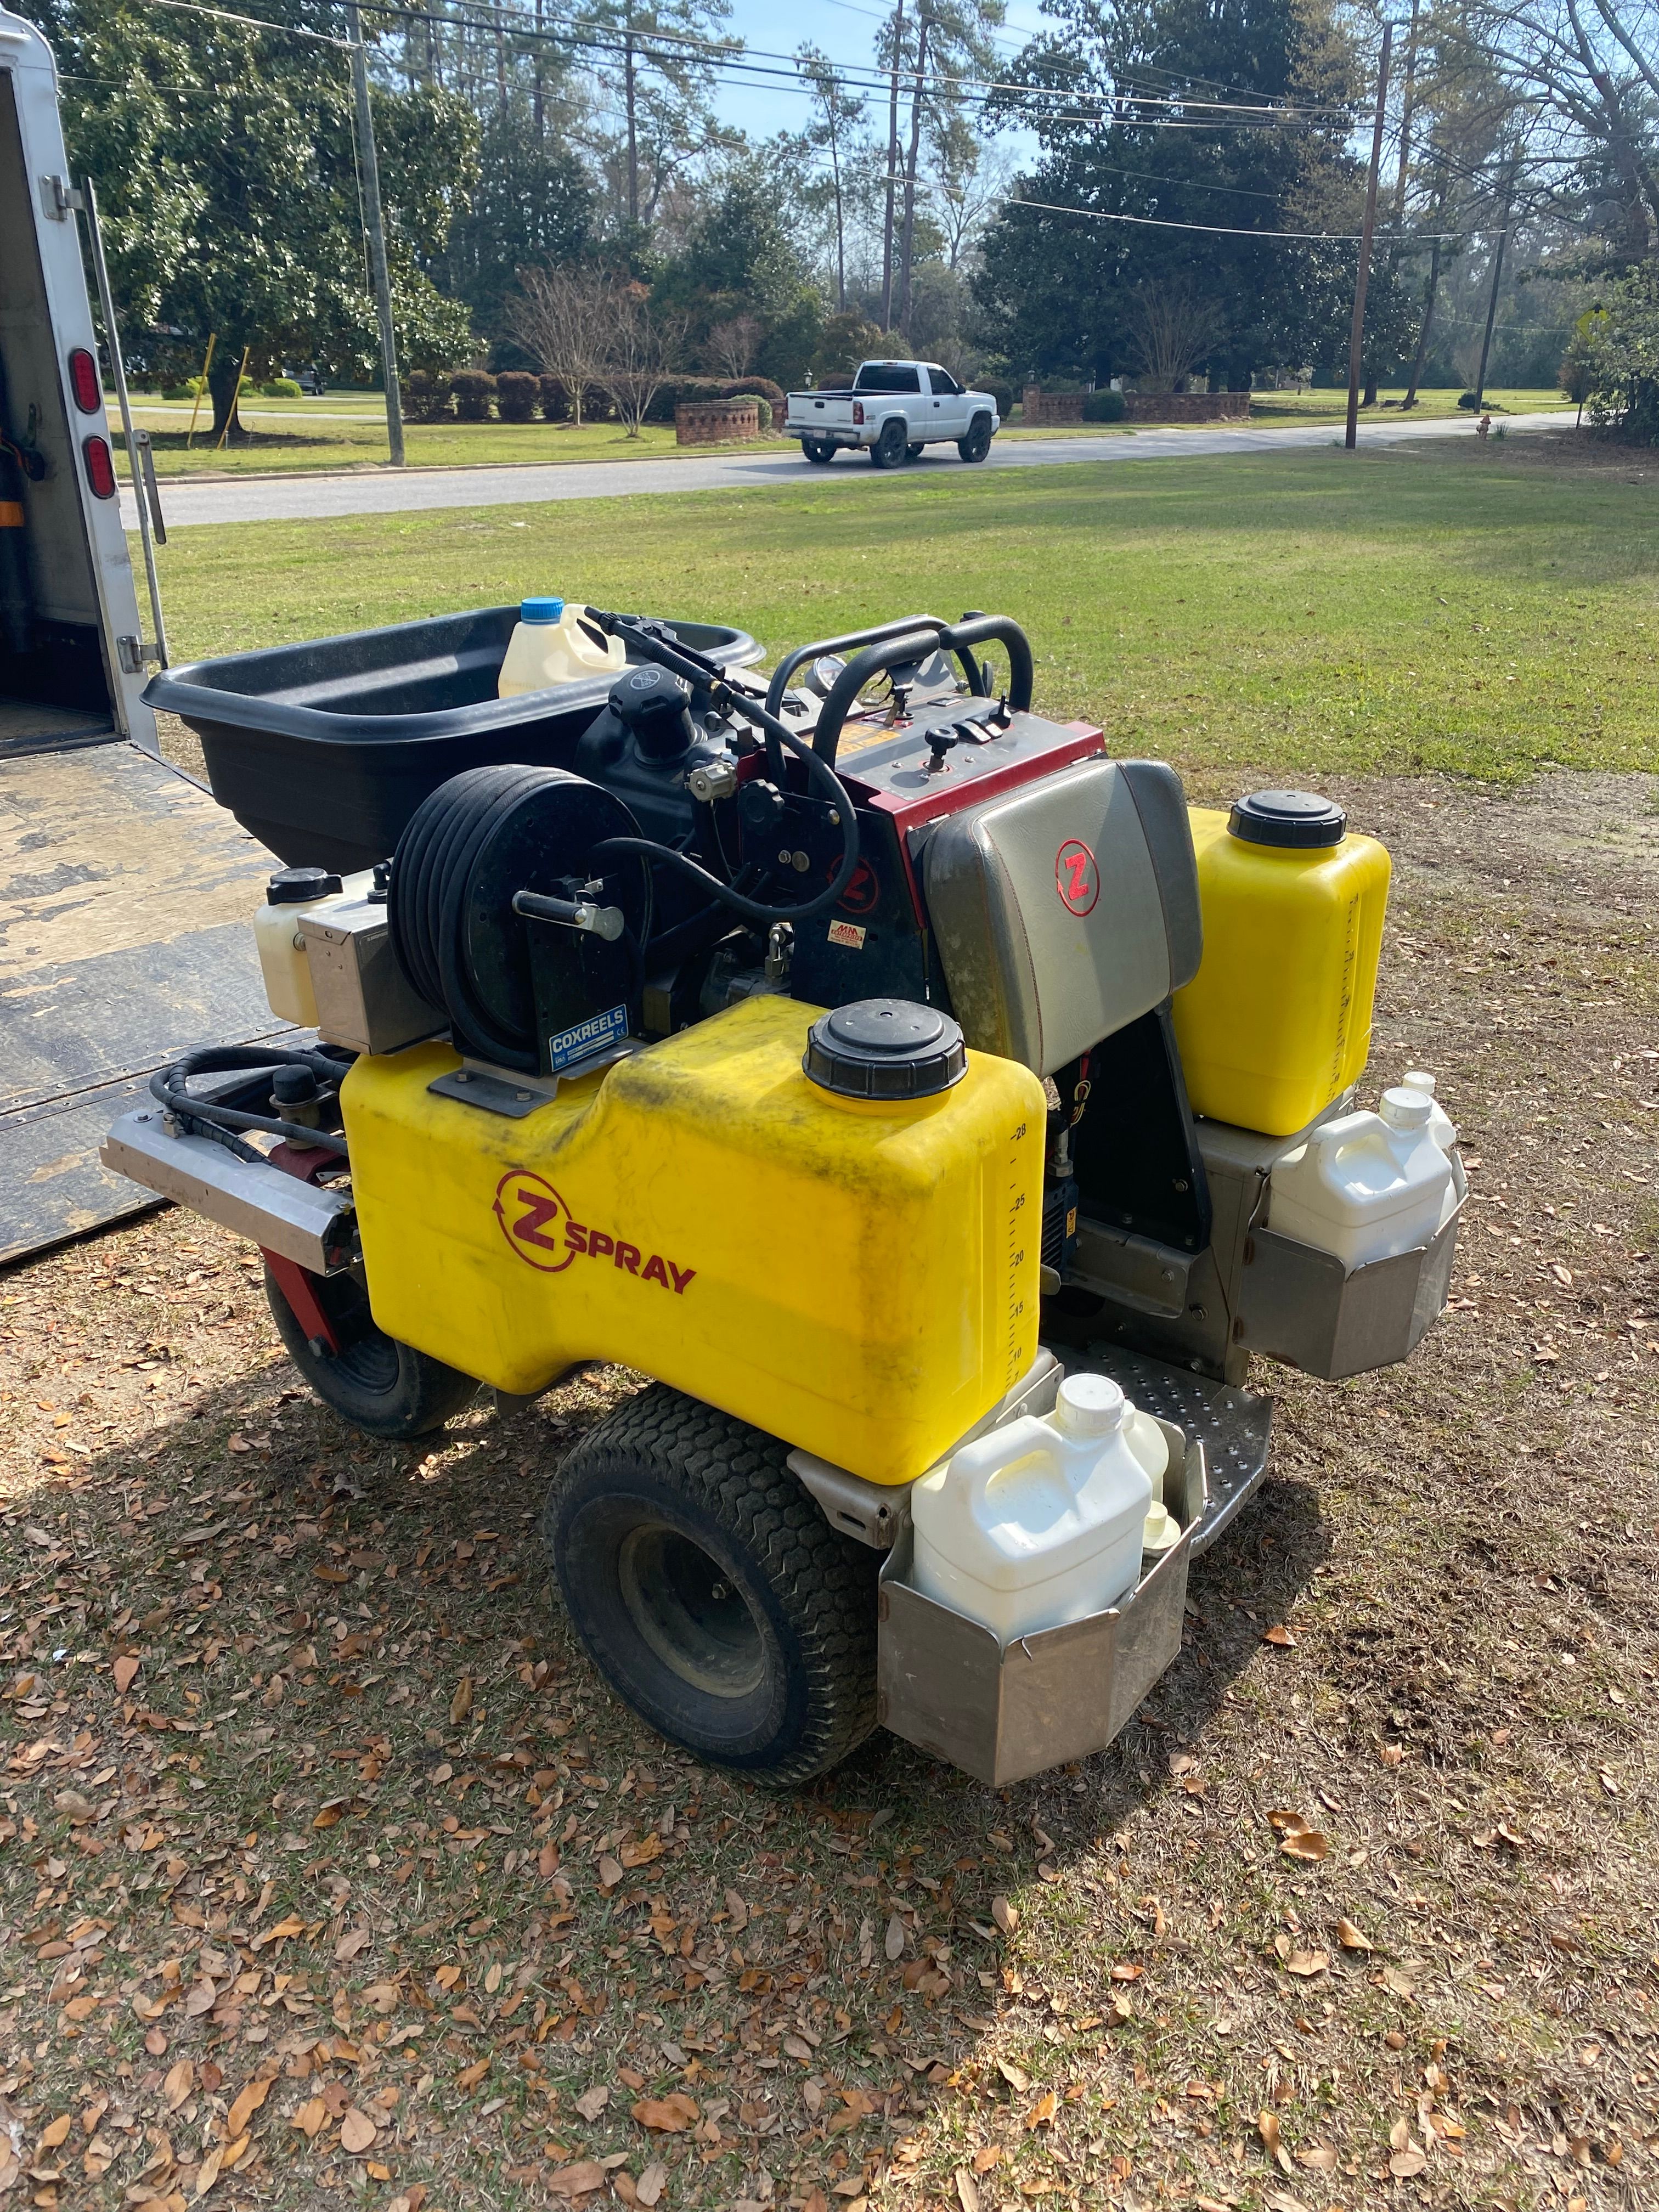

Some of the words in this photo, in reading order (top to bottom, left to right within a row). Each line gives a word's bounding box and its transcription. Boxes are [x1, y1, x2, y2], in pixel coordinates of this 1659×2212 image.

[1064, 853, 1089, 901] Z
[552, 1009, 624, 1053] COXREELS
[1017, 1123, 1026, 1141] 28
[1015, 1193, 1025, 1211] 25
[513, 1188, 557, 1251] Z
[564, 1220, 697, 1295] SPRAY
[1015, 1250, 1024, 1267] 20
[1015, 1301, 1023, 1317] 15
[1014, 1347, 1022, 1362] 10
